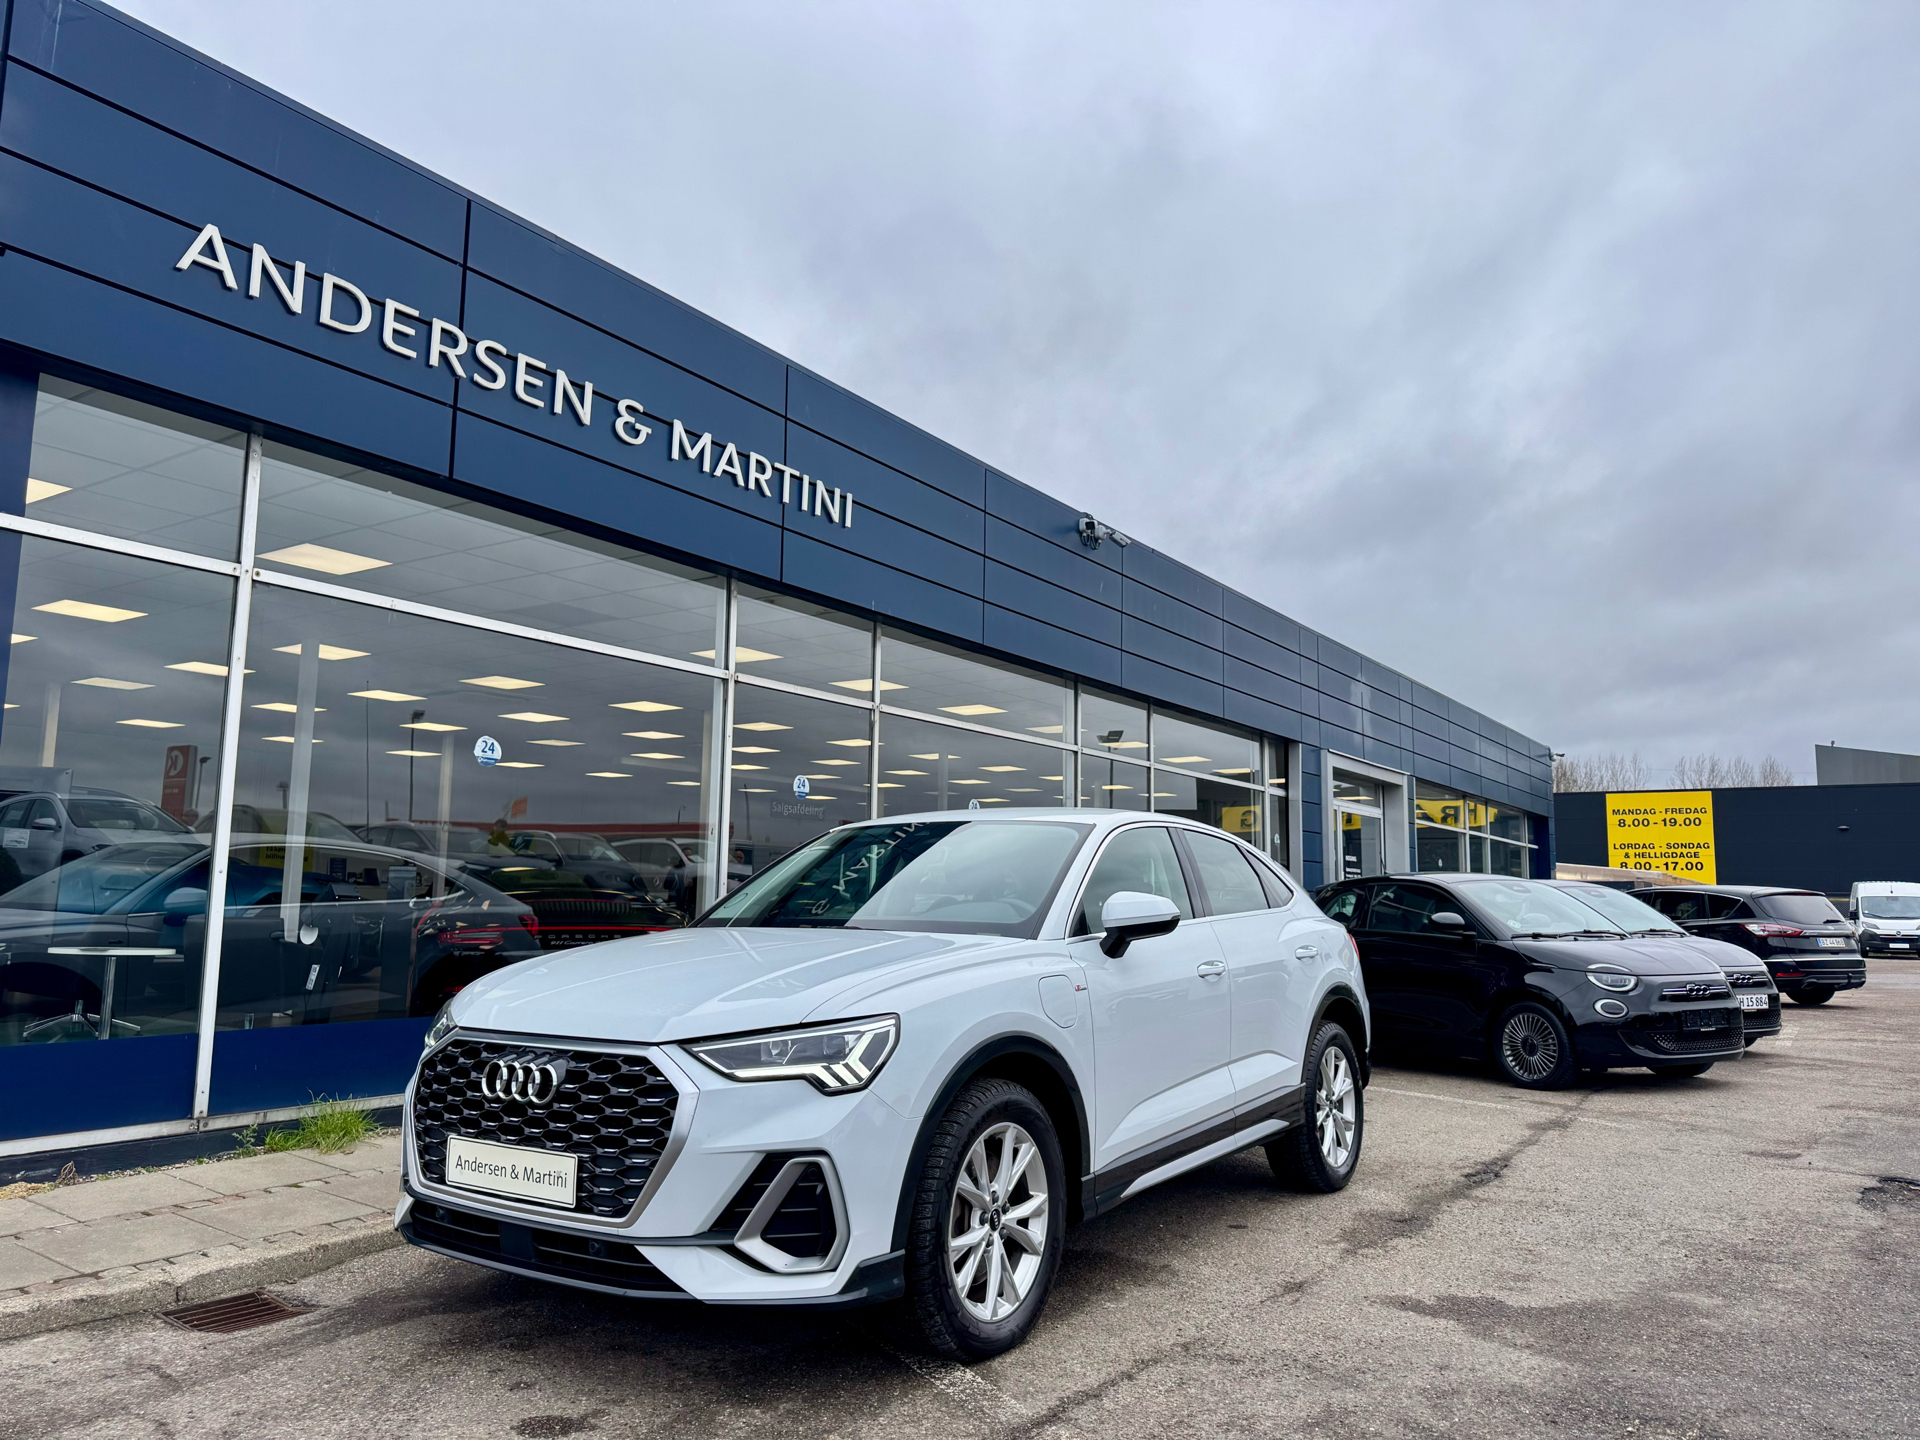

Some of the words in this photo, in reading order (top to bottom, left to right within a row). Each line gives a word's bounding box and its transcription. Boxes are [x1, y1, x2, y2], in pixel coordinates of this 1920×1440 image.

[174, 223, 593, 426] ANDERSEN
[614, 398, 652, 445] &
[670, 418, 853, 528] MARTINI
[481, 740, 495, 754] 24
[797, 778, 806, 790] 24
[771, 801, 825, 819] Salgsafdeling
[1612, 808, 1657, 816] MANDAG
[1664, 807, 1708, 815] FREDAG
[1617, 818, 1650, 828] 8.00
[1661, 817, 1702, 827] 19.00
[1666, 842, 1710, 850] SØNDAG
[1634, 851, 1700, 859] HELLIGDAGE
[1663, 861, 1704, 871] 17.00
[1746, 997, 1754, 1007] 15
[1755, 996, 1768, 1007] 884
[455, 1154, 507, 1178] Andersen
[510, 1164, 519, 1180] &
[522, 1165, 568, 1189] Martini
